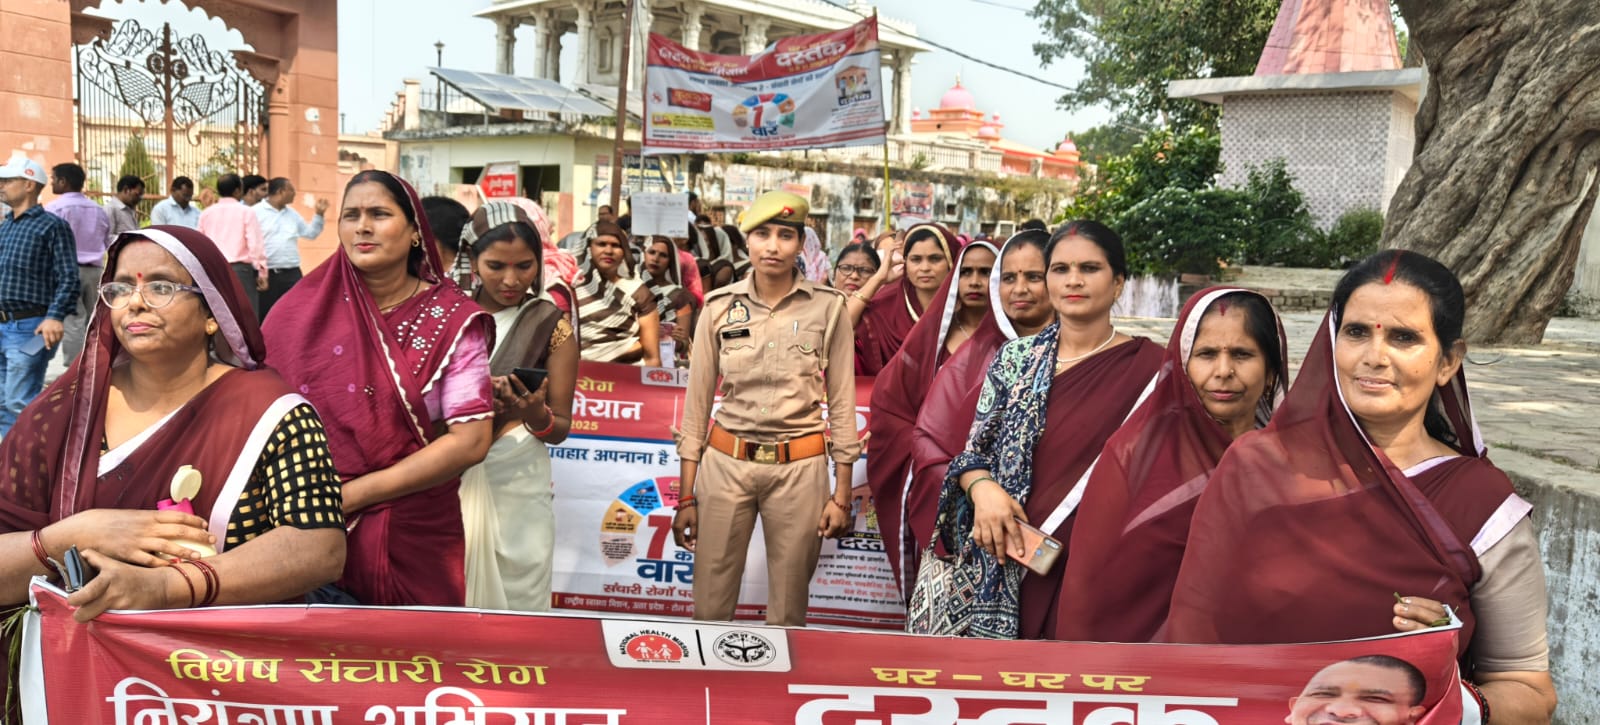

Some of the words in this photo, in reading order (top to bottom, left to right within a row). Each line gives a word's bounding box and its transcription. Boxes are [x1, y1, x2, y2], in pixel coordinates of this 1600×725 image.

[576, 376, 616, 392] रोग
[572, 391, 645, 420] भियान
[594, 449, 653, 464] अपनाना
[658, 449, 669, 465] है
[647, 515, 672, 560] 7
[841, 539, 885, 551] दस्त
[636, 558, 694, 584] वार
[603, 582, 642, 595] संचारी
[645, 584, 677, 597] रोगों
[640, 629, 671, 638] HEALTH
[165, 648, 283, 683] विशेष
[295, 652, 443, 684] संचारी
[456, 658, 549, 685] रोग
[871, 667, 942, 685] घर
[998, 671, 1071, 690] घर
[1080, 673, 1151, 692] पर
